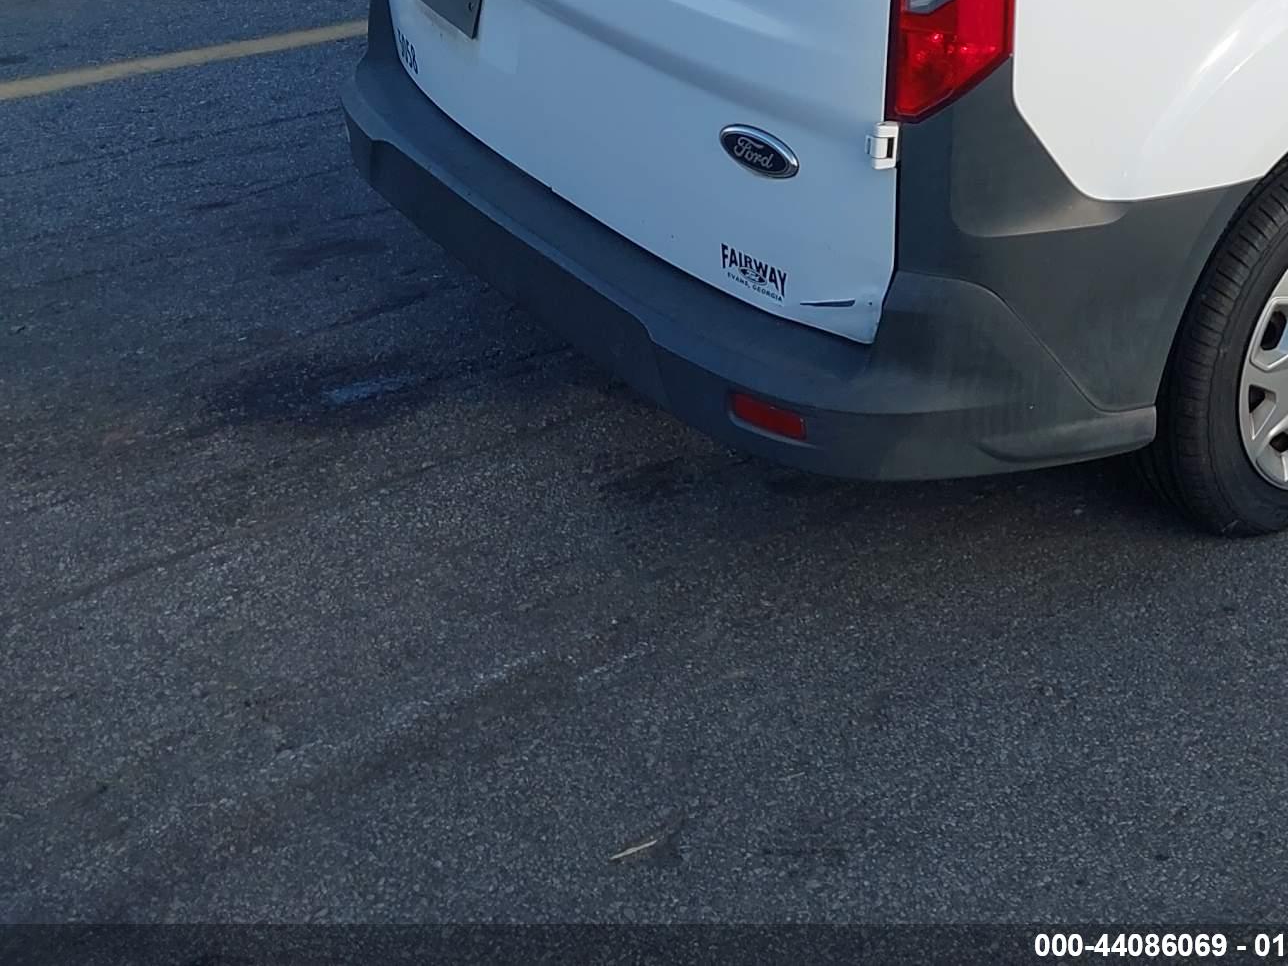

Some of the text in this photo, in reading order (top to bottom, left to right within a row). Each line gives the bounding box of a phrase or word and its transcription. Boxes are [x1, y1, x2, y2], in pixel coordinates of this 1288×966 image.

[733, 136, 774, 169] Ford
[721, 242, 787, 298] FAIRWAY
[752, 284, 783, 302] GEORGIA
